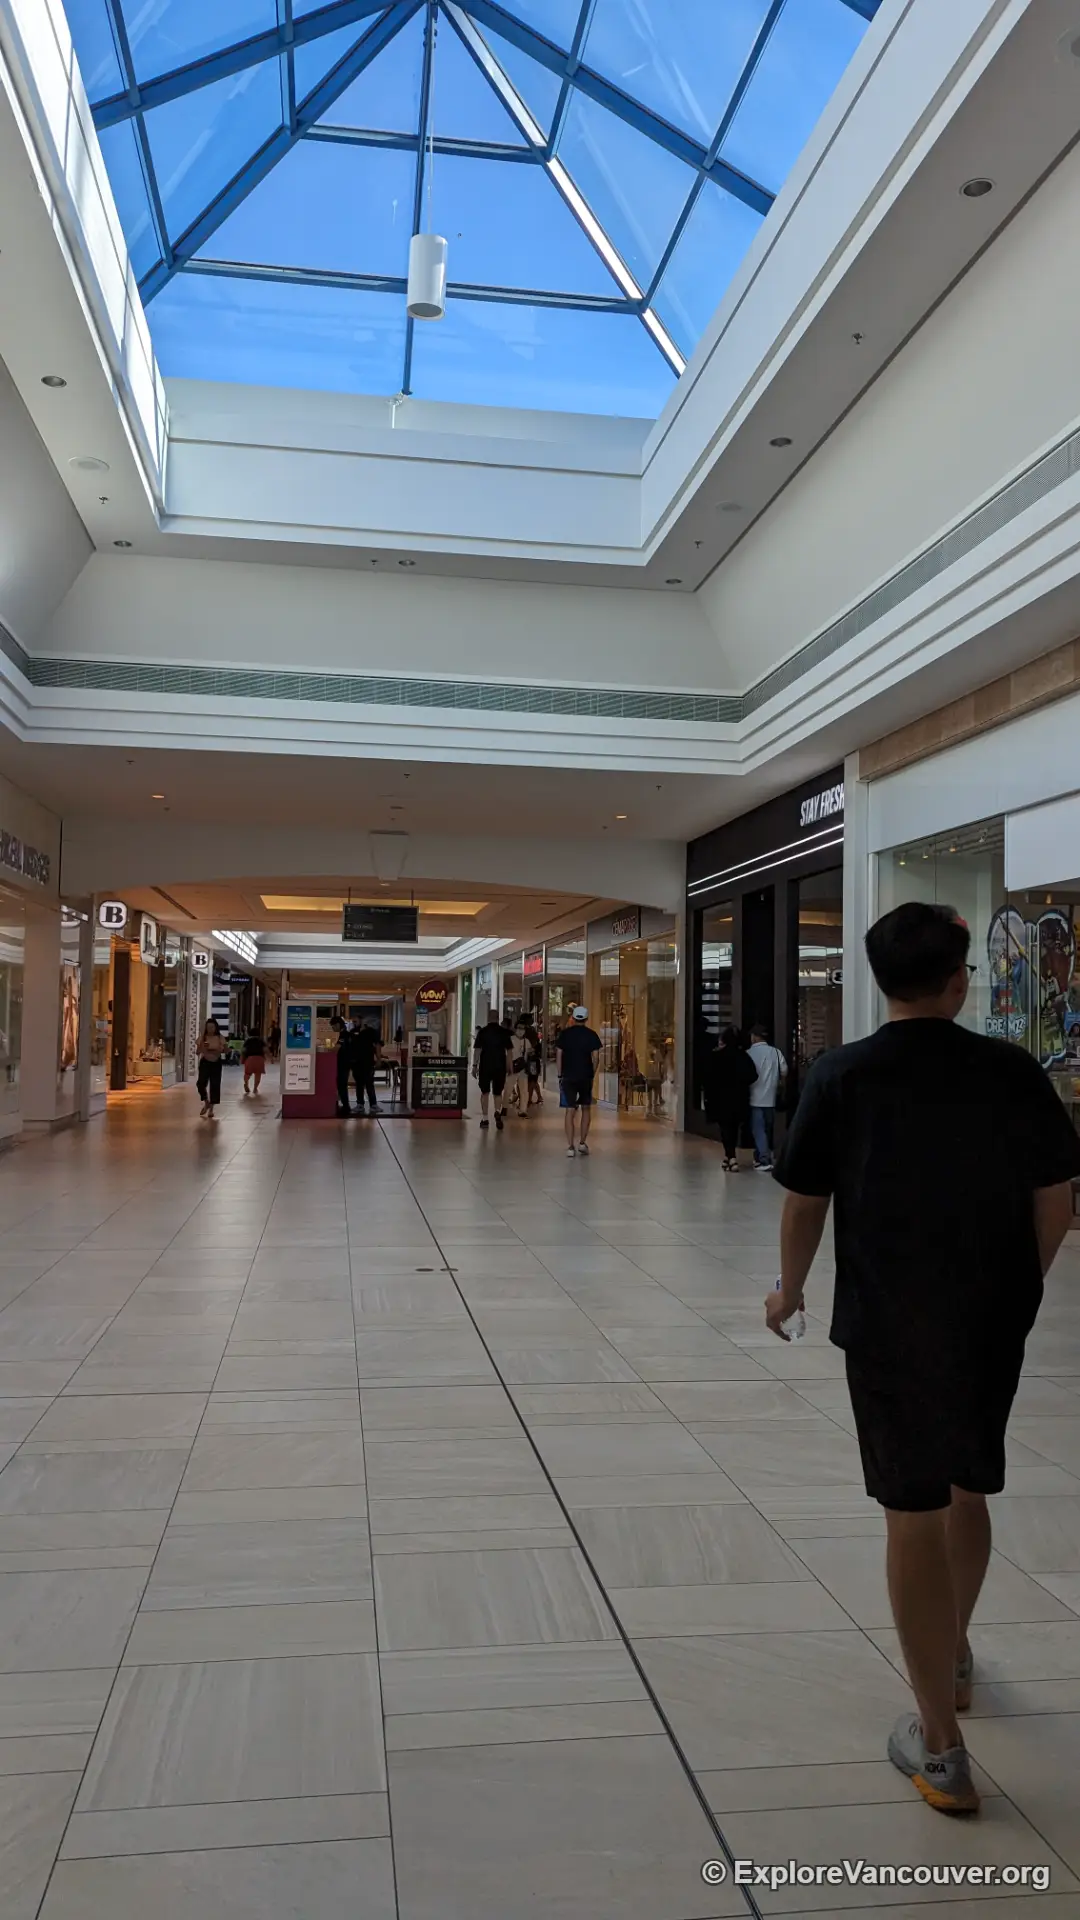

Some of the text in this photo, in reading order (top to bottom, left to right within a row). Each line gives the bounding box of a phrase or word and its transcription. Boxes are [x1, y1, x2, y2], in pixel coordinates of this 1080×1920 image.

[800, 782, 845, 827] STAY FRESH
[101, 905, 124, 923] B
[194, 954, 207, 965] B
[924, 1762, 947, 1777] HOKA
